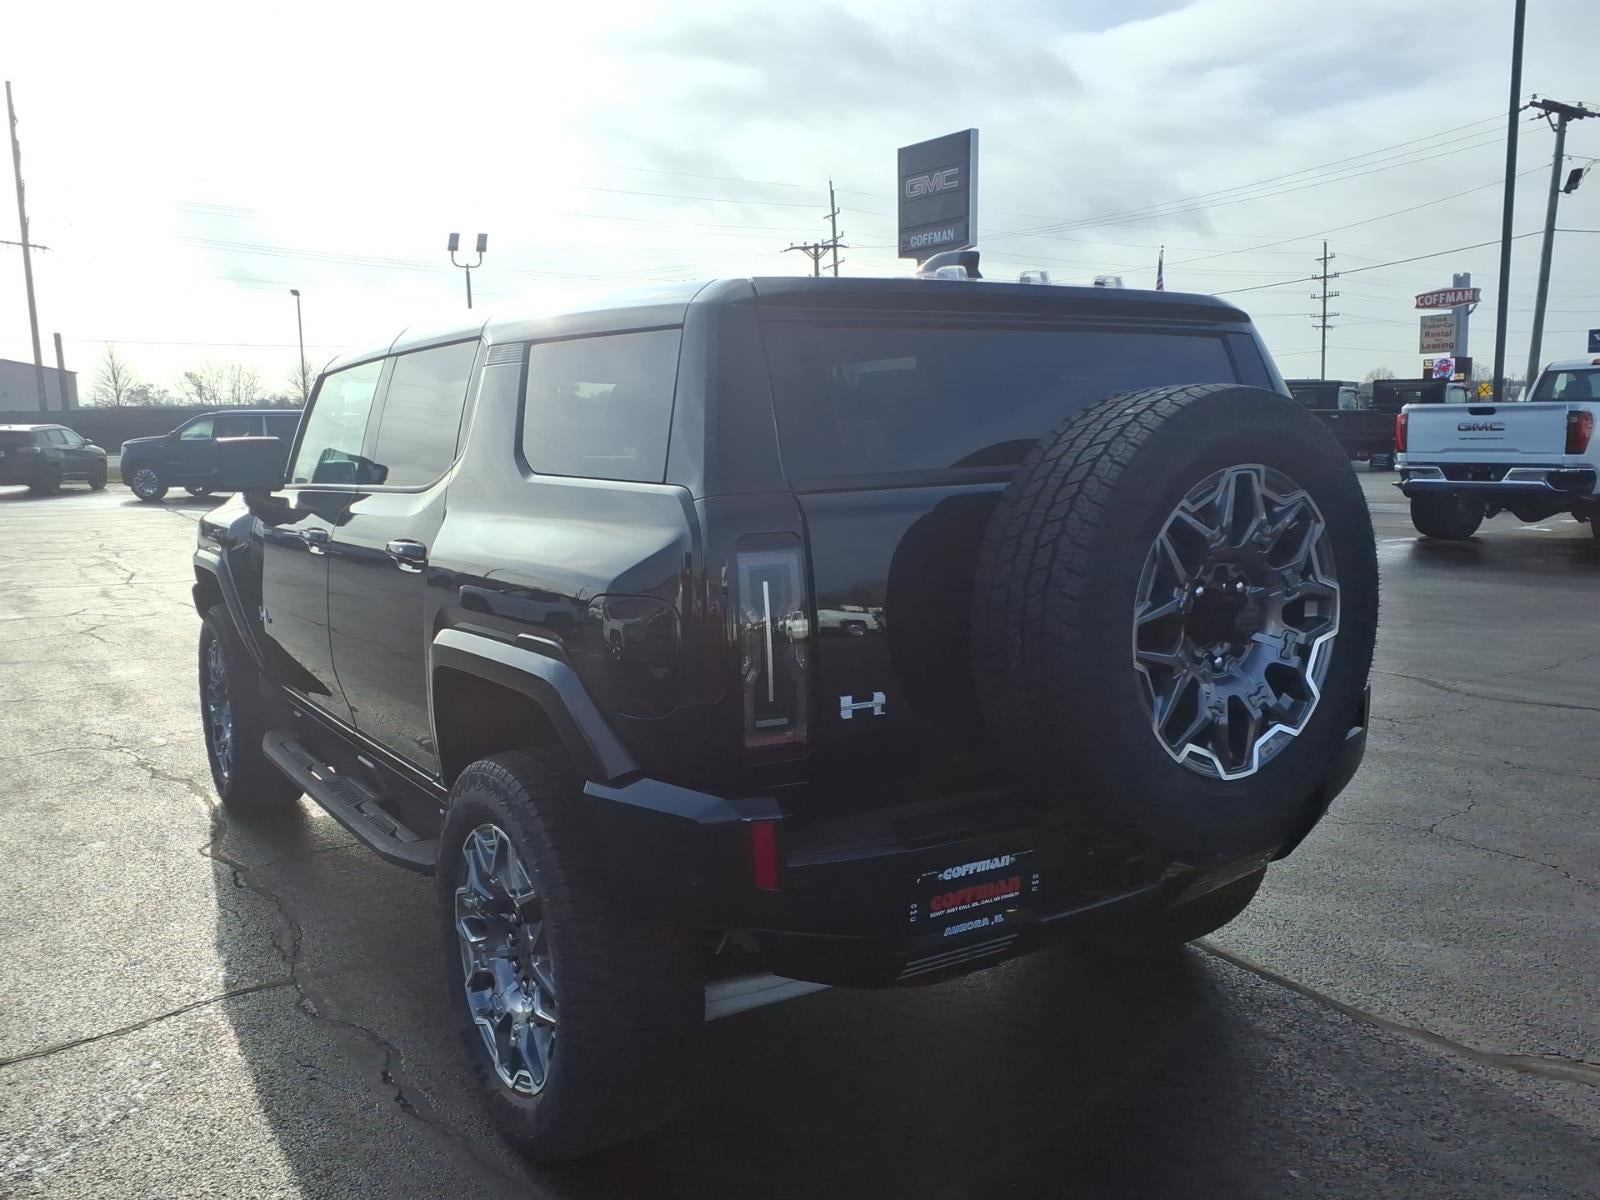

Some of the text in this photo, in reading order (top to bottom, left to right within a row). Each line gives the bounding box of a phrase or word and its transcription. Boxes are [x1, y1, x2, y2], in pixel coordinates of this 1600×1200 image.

[905, 167, 959, 198] GMC
[910, 229, 954, 248] COFFMAN
[1417, 290, 1473, 306] COFFMAN
[1424, 329, 1452, 338] Rental
[1421, 341, 1455, 350] Leasing
[1458, 422, 1505, 431] GMC
[943, 855, 1010, 880] COFFMAN
[930, 876, 1021, 911] COFFMAN
[943, 917, 989, 937] AURORA
